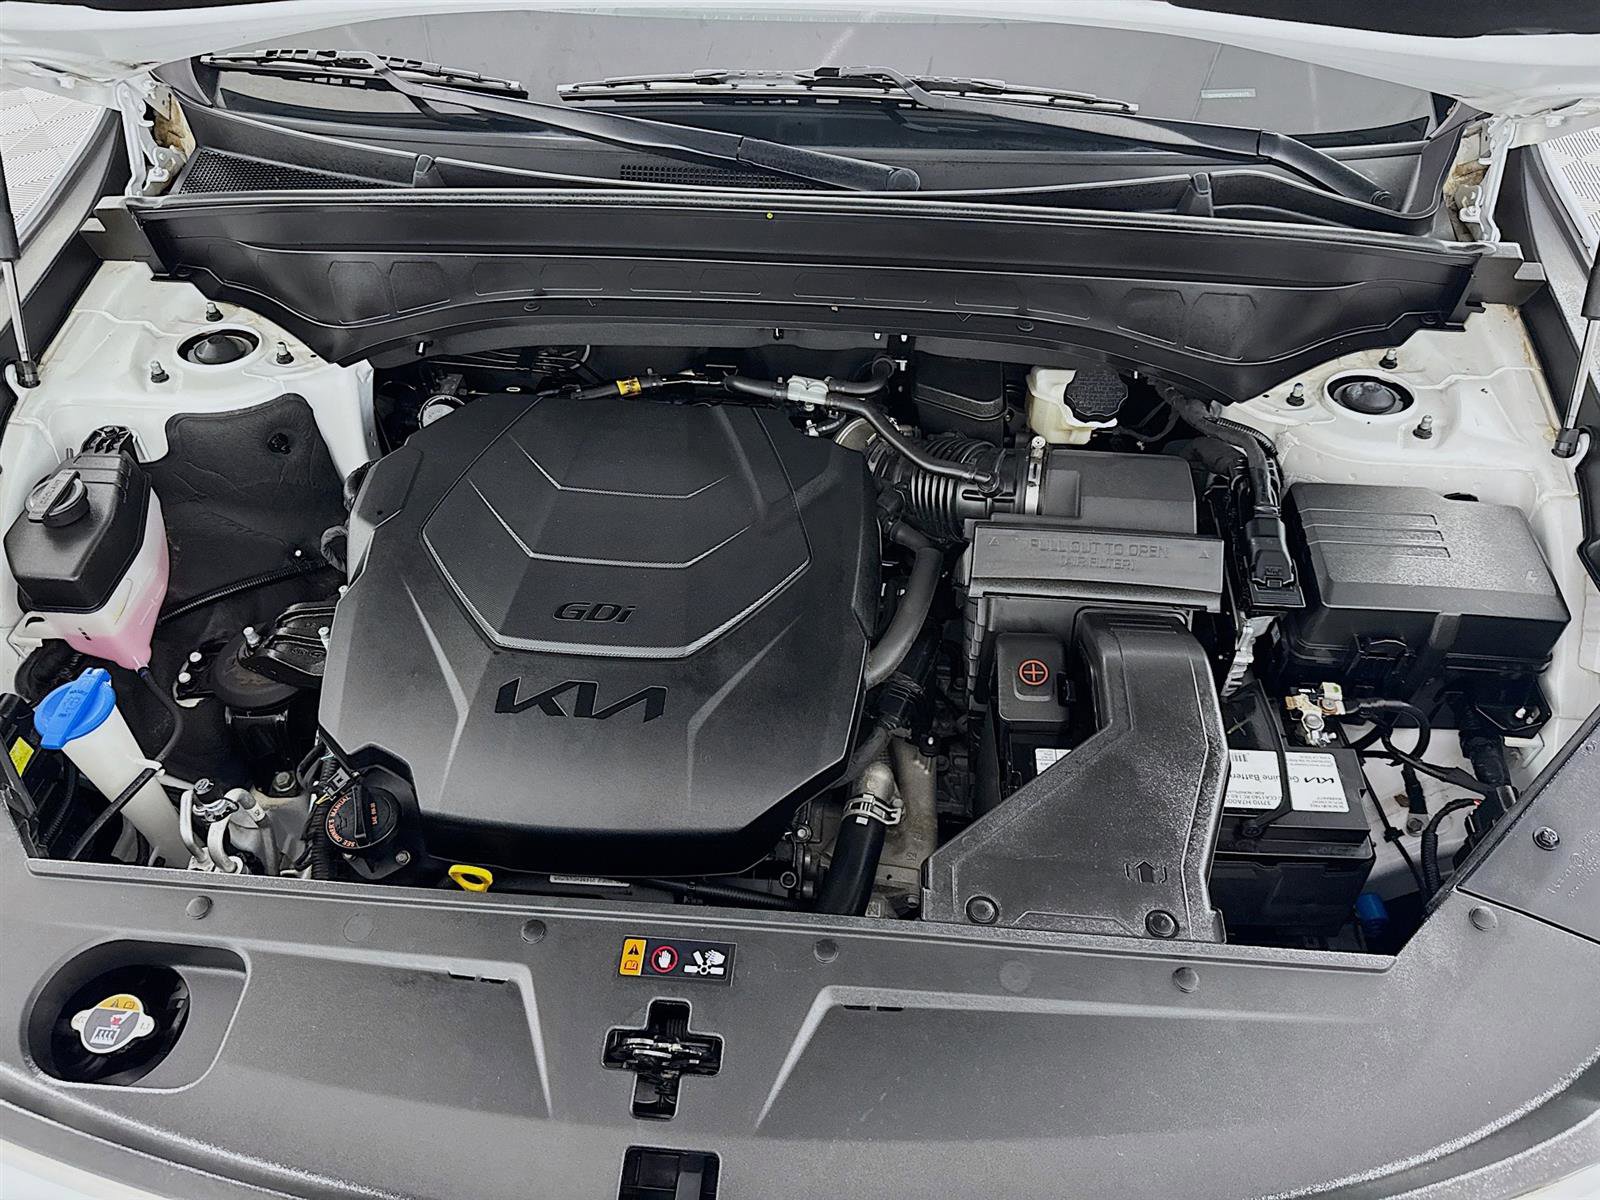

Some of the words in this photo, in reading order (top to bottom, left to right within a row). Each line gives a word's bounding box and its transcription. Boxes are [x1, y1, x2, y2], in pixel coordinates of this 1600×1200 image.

[1071, 541, 1101, 555] OUT
[1104, 542, 1124, 556] TO
[1128, 544, 1169, 559] OPEN
[552, 601, 637, 624] GDi
[494, 676, 669, 723] KIA
